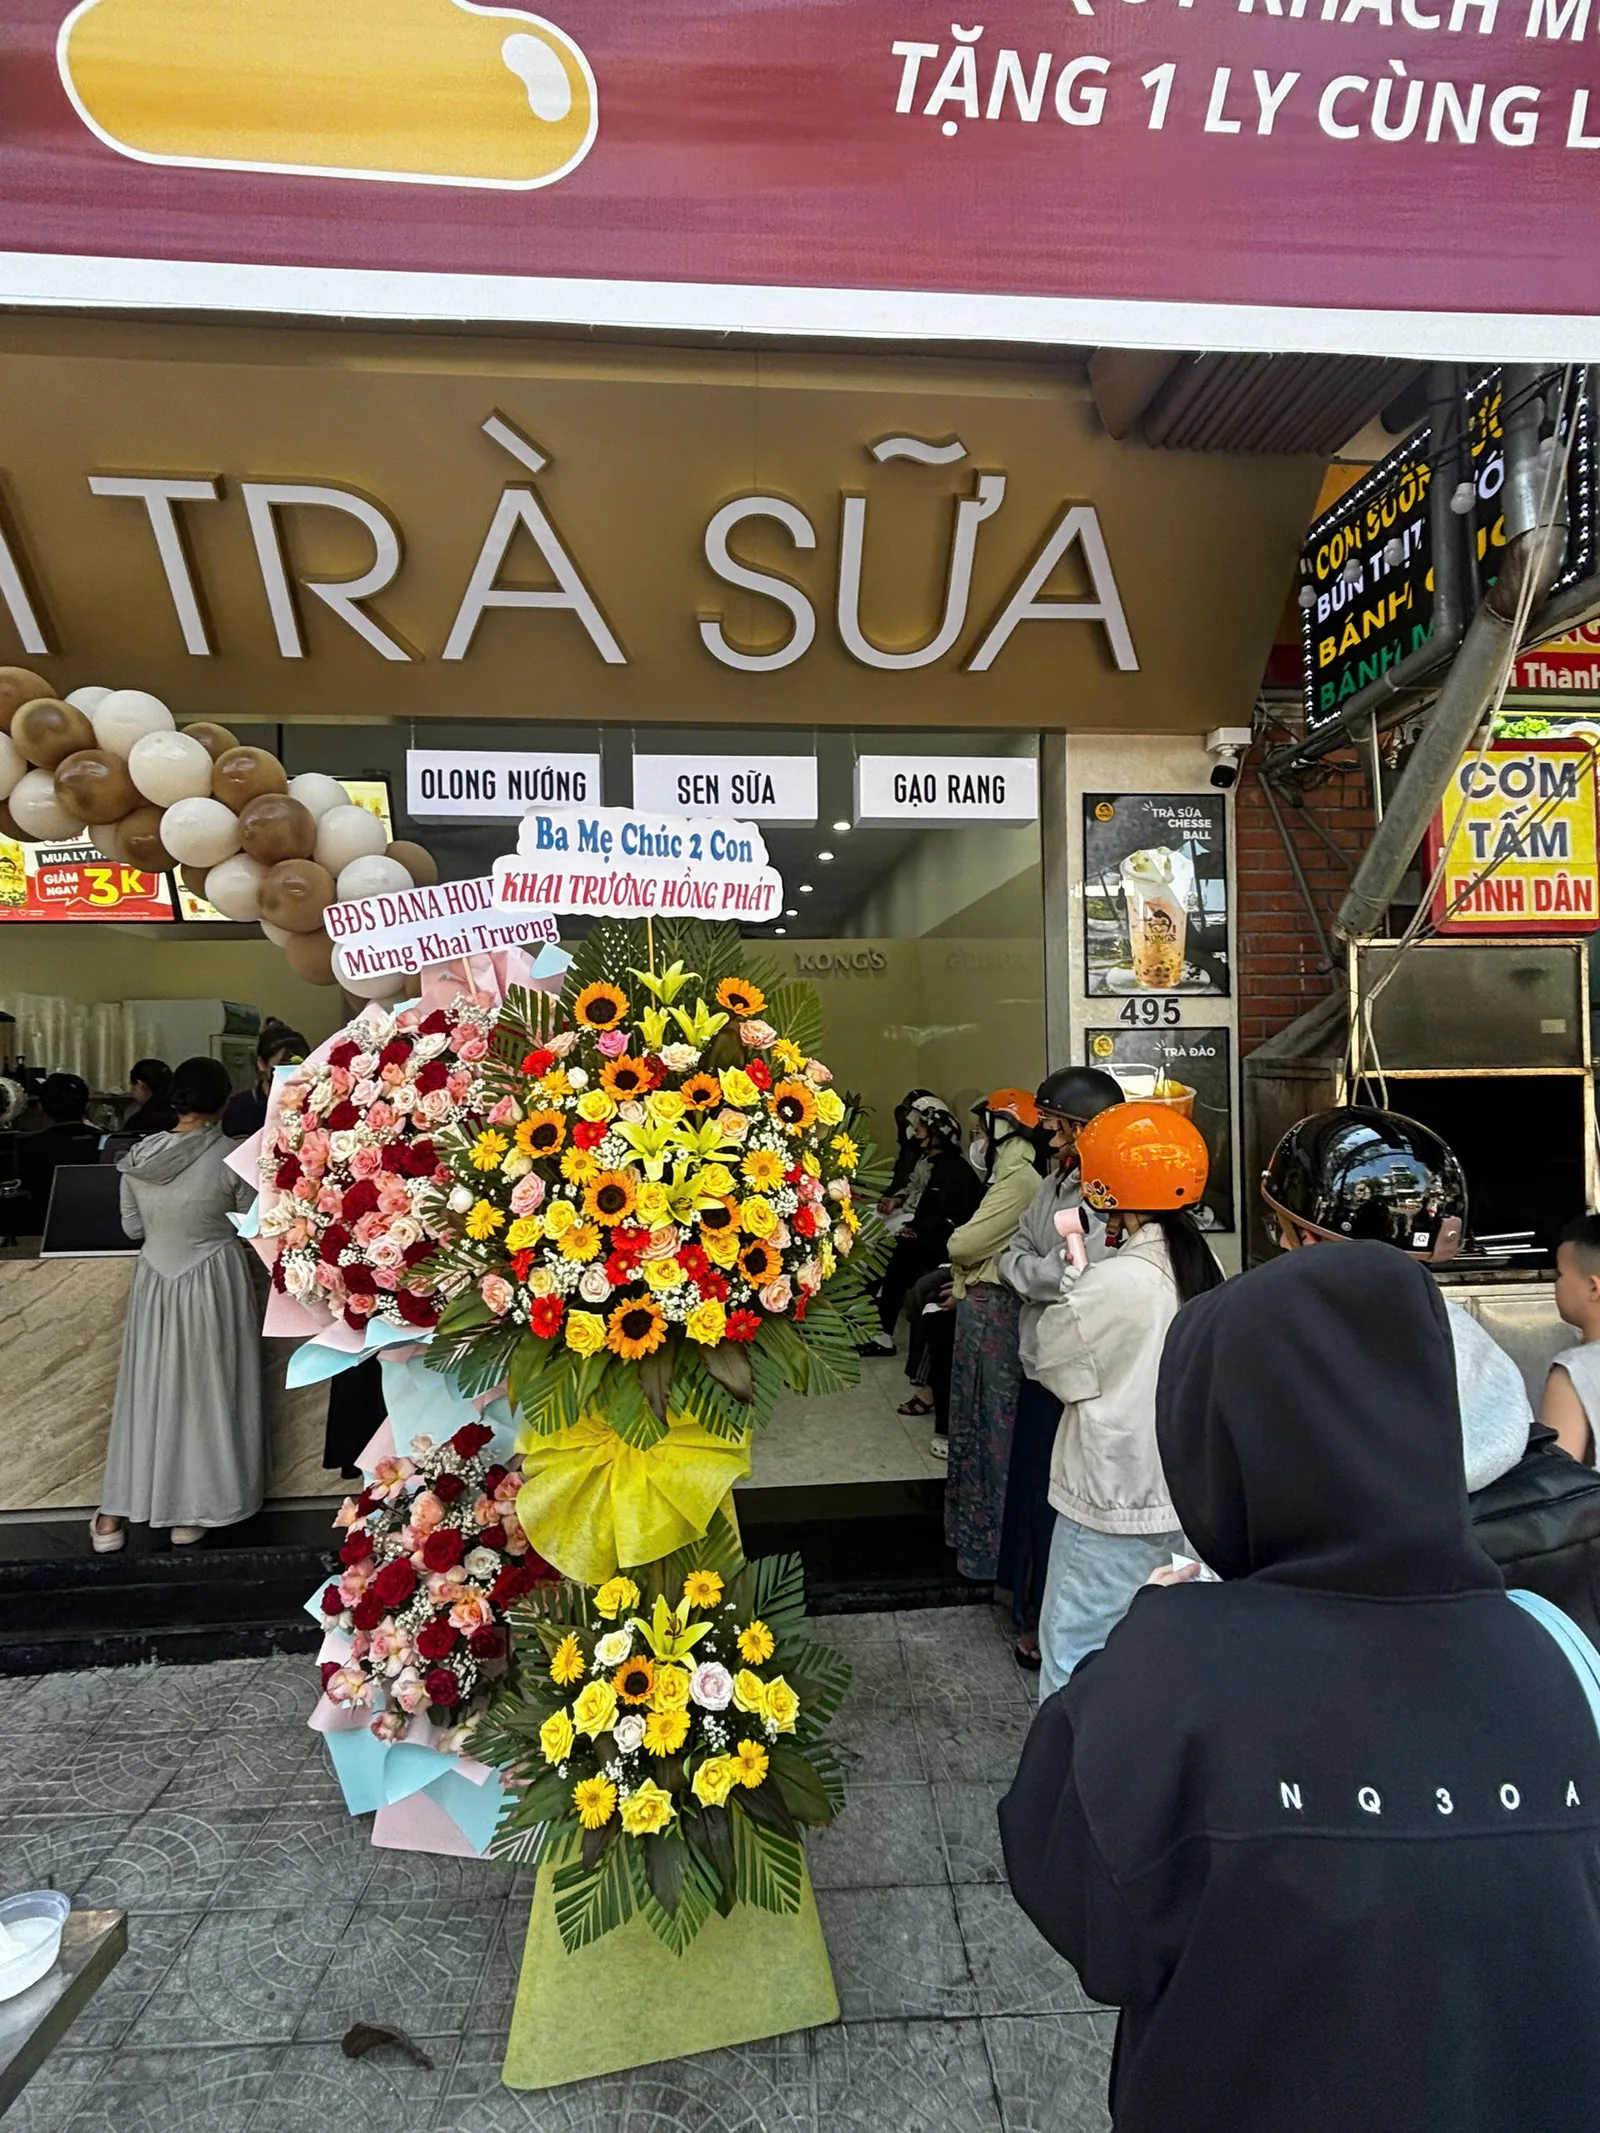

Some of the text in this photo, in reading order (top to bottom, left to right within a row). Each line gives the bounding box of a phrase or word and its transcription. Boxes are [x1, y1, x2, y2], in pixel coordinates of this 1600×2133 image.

[892, 23, 1111, 137] TẶNG
[1141, 63, 1177, 130] 1
[1204, 67, 1300, 135] LY
[1318, 58, 1541, 147] CÙNG
[87, 412, 628, 664] TRÀ
[698, 434, 1140, 673] SỮA
[1319, 580, 1413, 668] BÁNH
[420, 765, 587, 802] OLONG NƯỚNG
[677, 769, 776, 805] SEN SỮA
[893, 774, 1006, 808] GẠO RANG
[1460, 756, 1577, 799] CƠM
[1151, 806, 1175, 818] TRÀ
[1167, 819, 1212, 828] CHESSE
[536, 816, 753, 863] Ba Mẹ Chúc 2 Con
[1182, 830, 1212, 840] BALL
[1469, 806, 1568, 859] TẤM
[41, 852, 72, 863] MUA
[73, 851, 87, 861] LY
[43, 869, 79, 885] GIẢM
[46, 885, 78, 896] NGAY
[501, 866, 776, 911] KHAI TRƯƠNG HỒNG PHÁT
[1454, 872, 1593, 913] BÌNH DÂN
[327, 899, 376, 937] BĐS
[374, 888, 444, 928] DANA
[344, 917, 558, 977] Mừng Khai Trương
[1119, 997, 1181, 1025] 495
[1163, 1045, 1216, 1057] TRÀ ĐÀO
